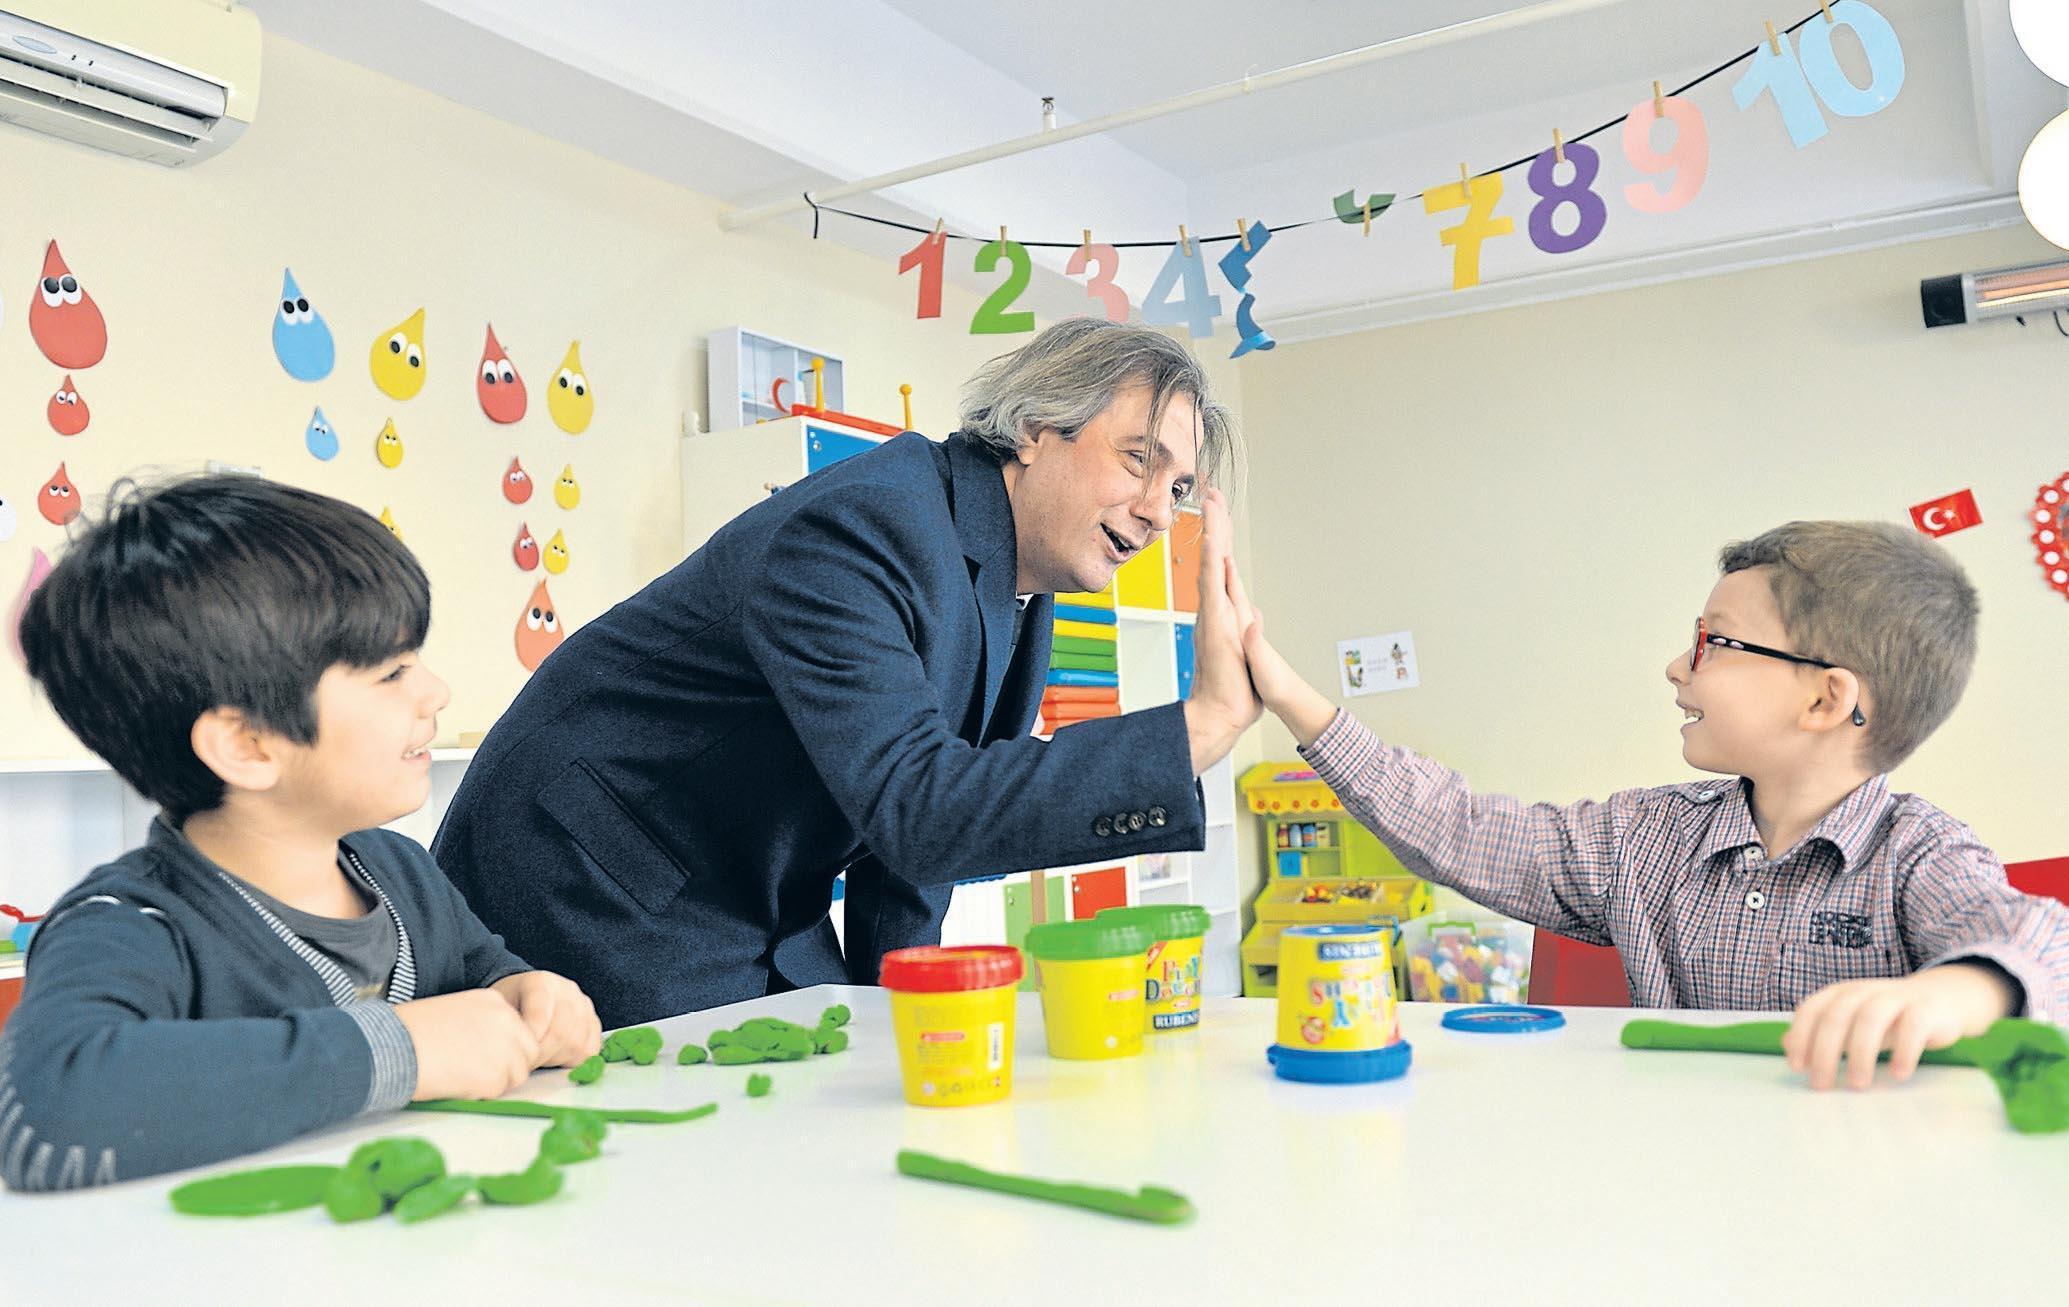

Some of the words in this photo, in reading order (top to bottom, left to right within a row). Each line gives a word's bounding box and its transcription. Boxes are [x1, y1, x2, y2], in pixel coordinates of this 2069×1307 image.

[898, 230, 948, 320] 1
[970, 240, 1036, 335] 2
[1065, 243, 1130, 324] 3
[1141, 235, 1223, 339] 4
[1422, 171, 1514, 292] 7
[1527, 142, 1608, 255] 8
[1622, 95, 1709, 214] 9
[1731, 0, 1906, 150] 10
